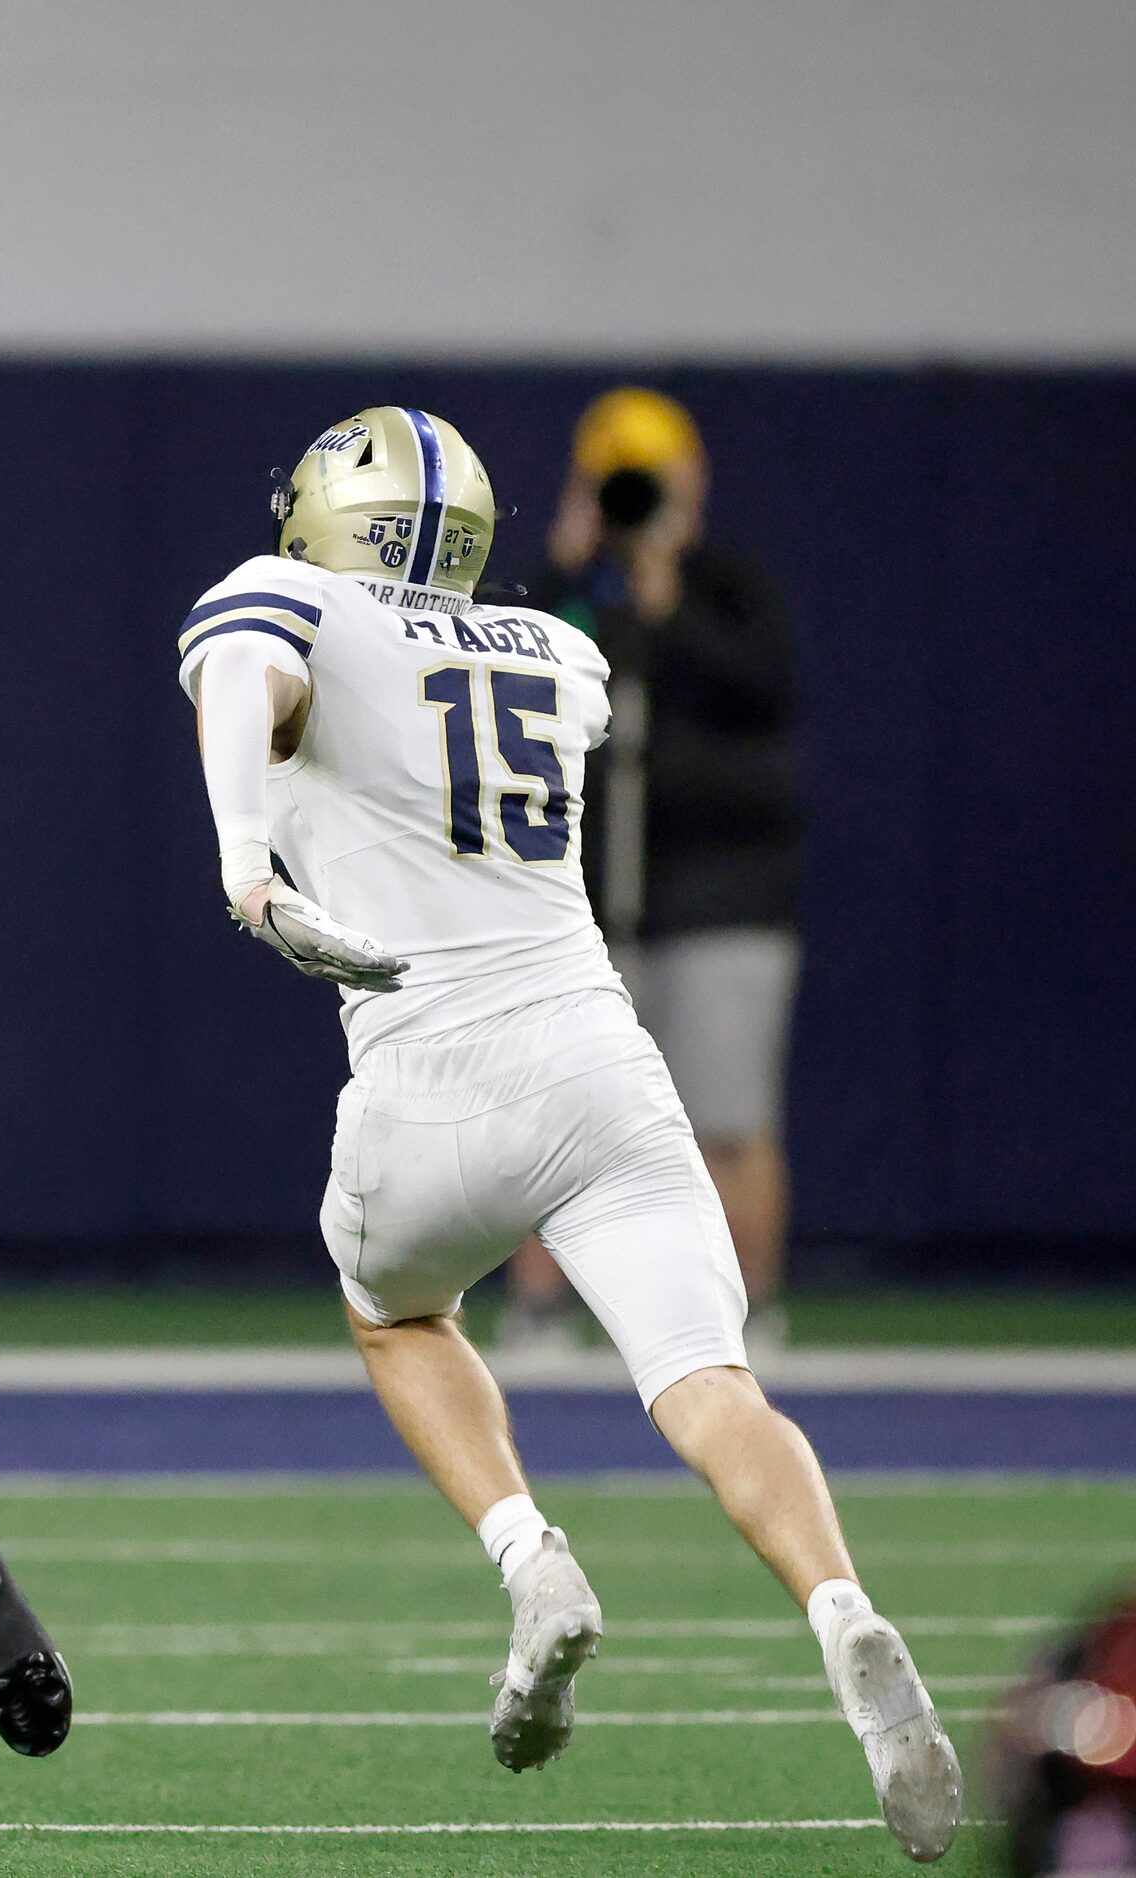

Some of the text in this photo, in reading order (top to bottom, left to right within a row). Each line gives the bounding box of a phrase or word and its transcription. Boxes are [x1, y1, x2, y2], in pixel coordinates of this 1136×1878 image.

[444, 528, 459, 544] 27
[383, 543, 404, 566] 15
[354, 580, 395, 605] AR
[417, 659, 569, 868] 15
